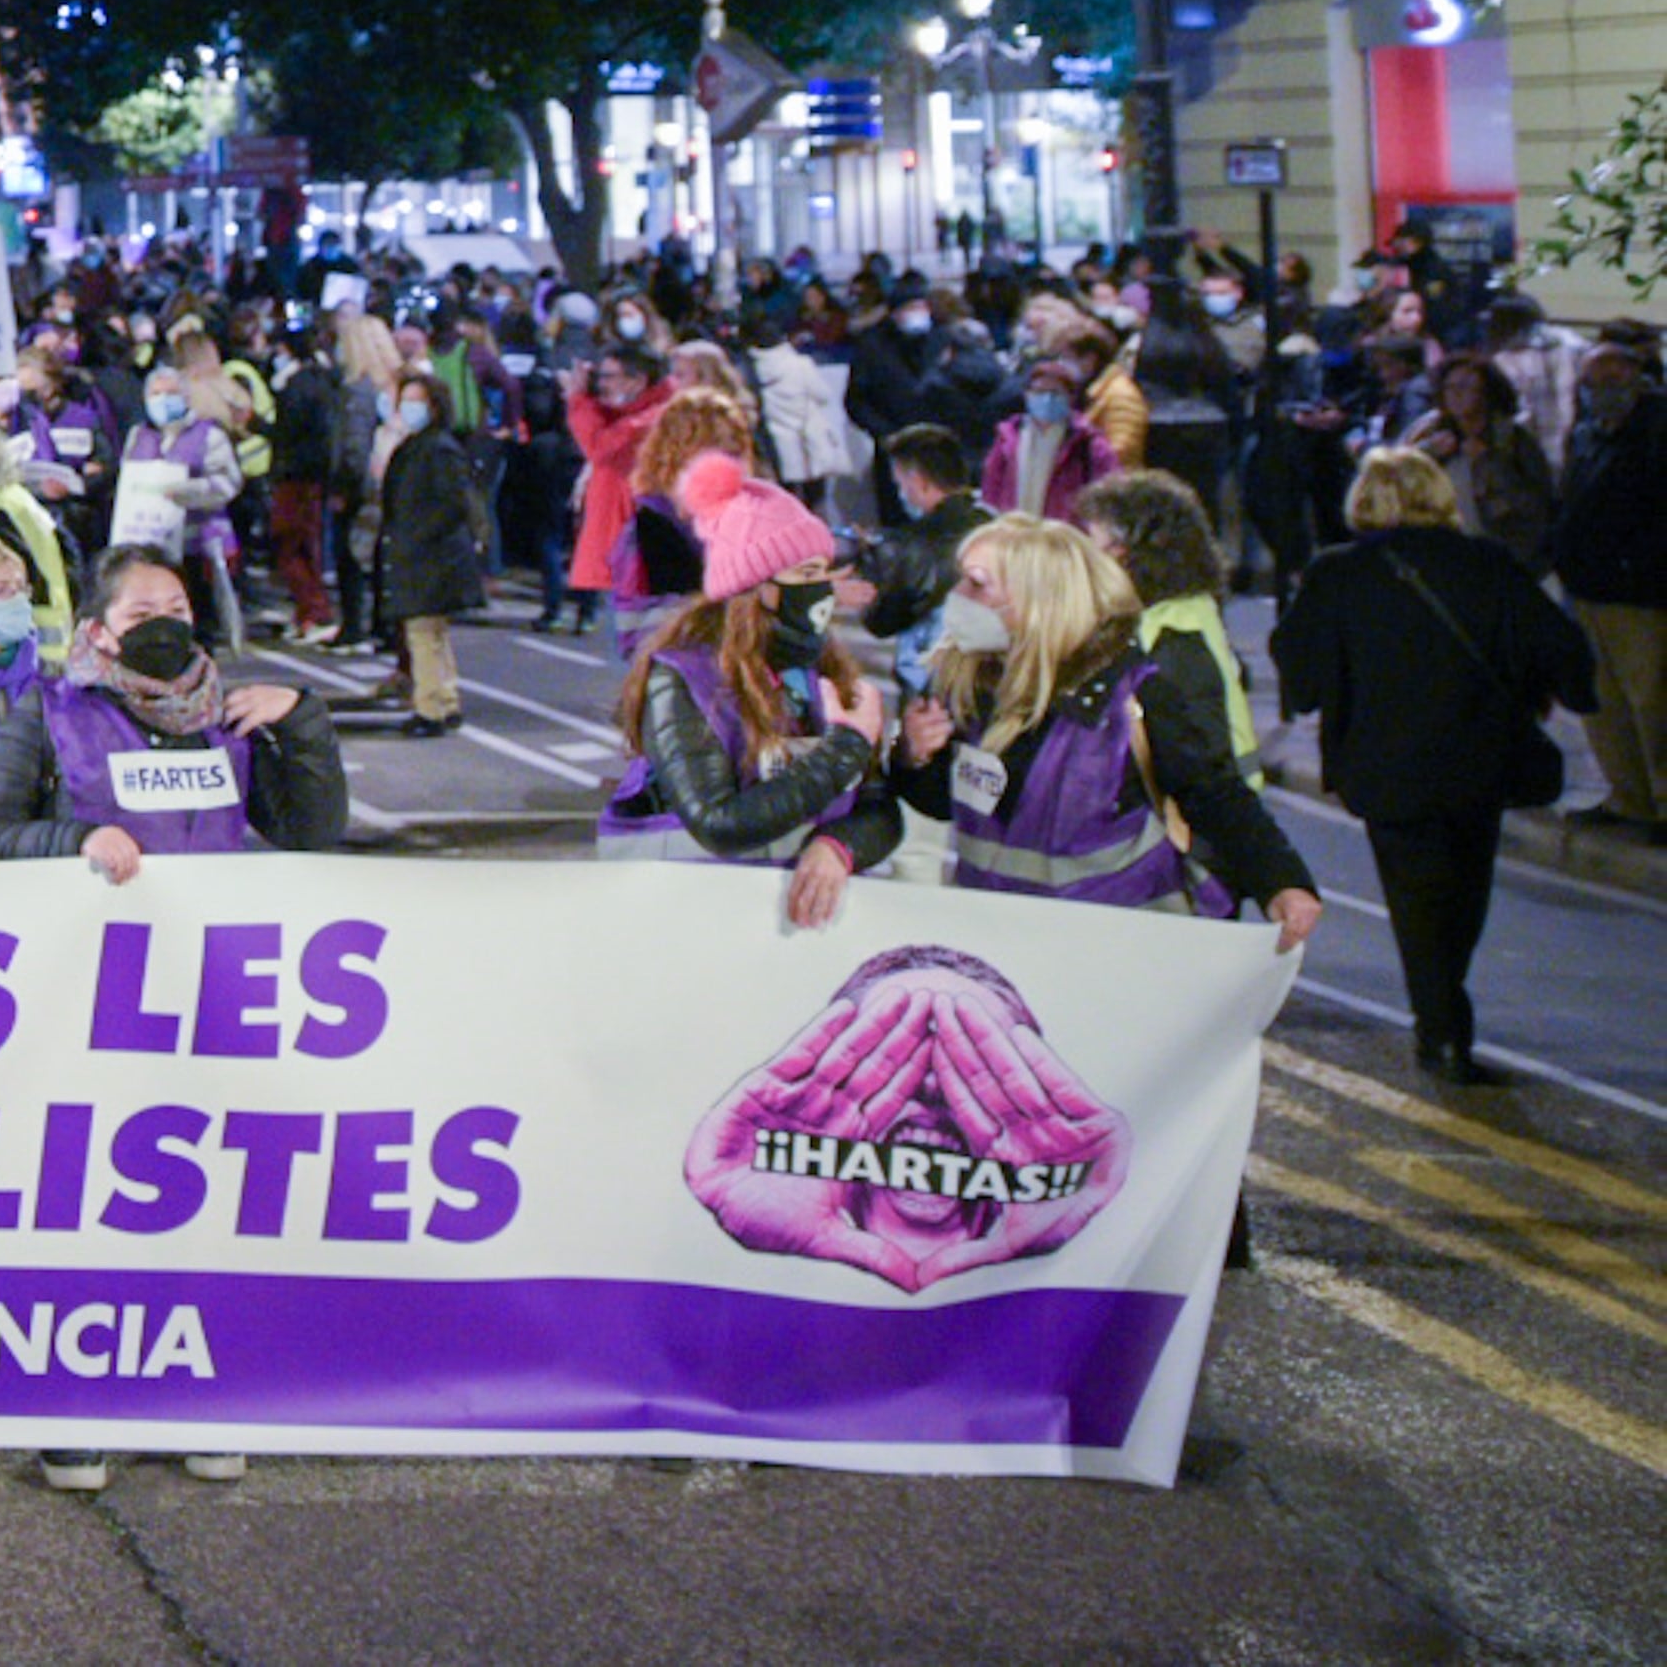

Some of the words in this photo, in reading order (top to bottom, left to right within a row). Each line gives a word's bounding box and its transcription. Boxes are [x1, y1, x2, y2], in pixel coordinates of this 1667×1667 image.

[122, 764, 226, 792] #FARTES
[90, 919, 389, 1059] LES
[753, 1131, 1087, 1203] ¡¡HARTAS!!
